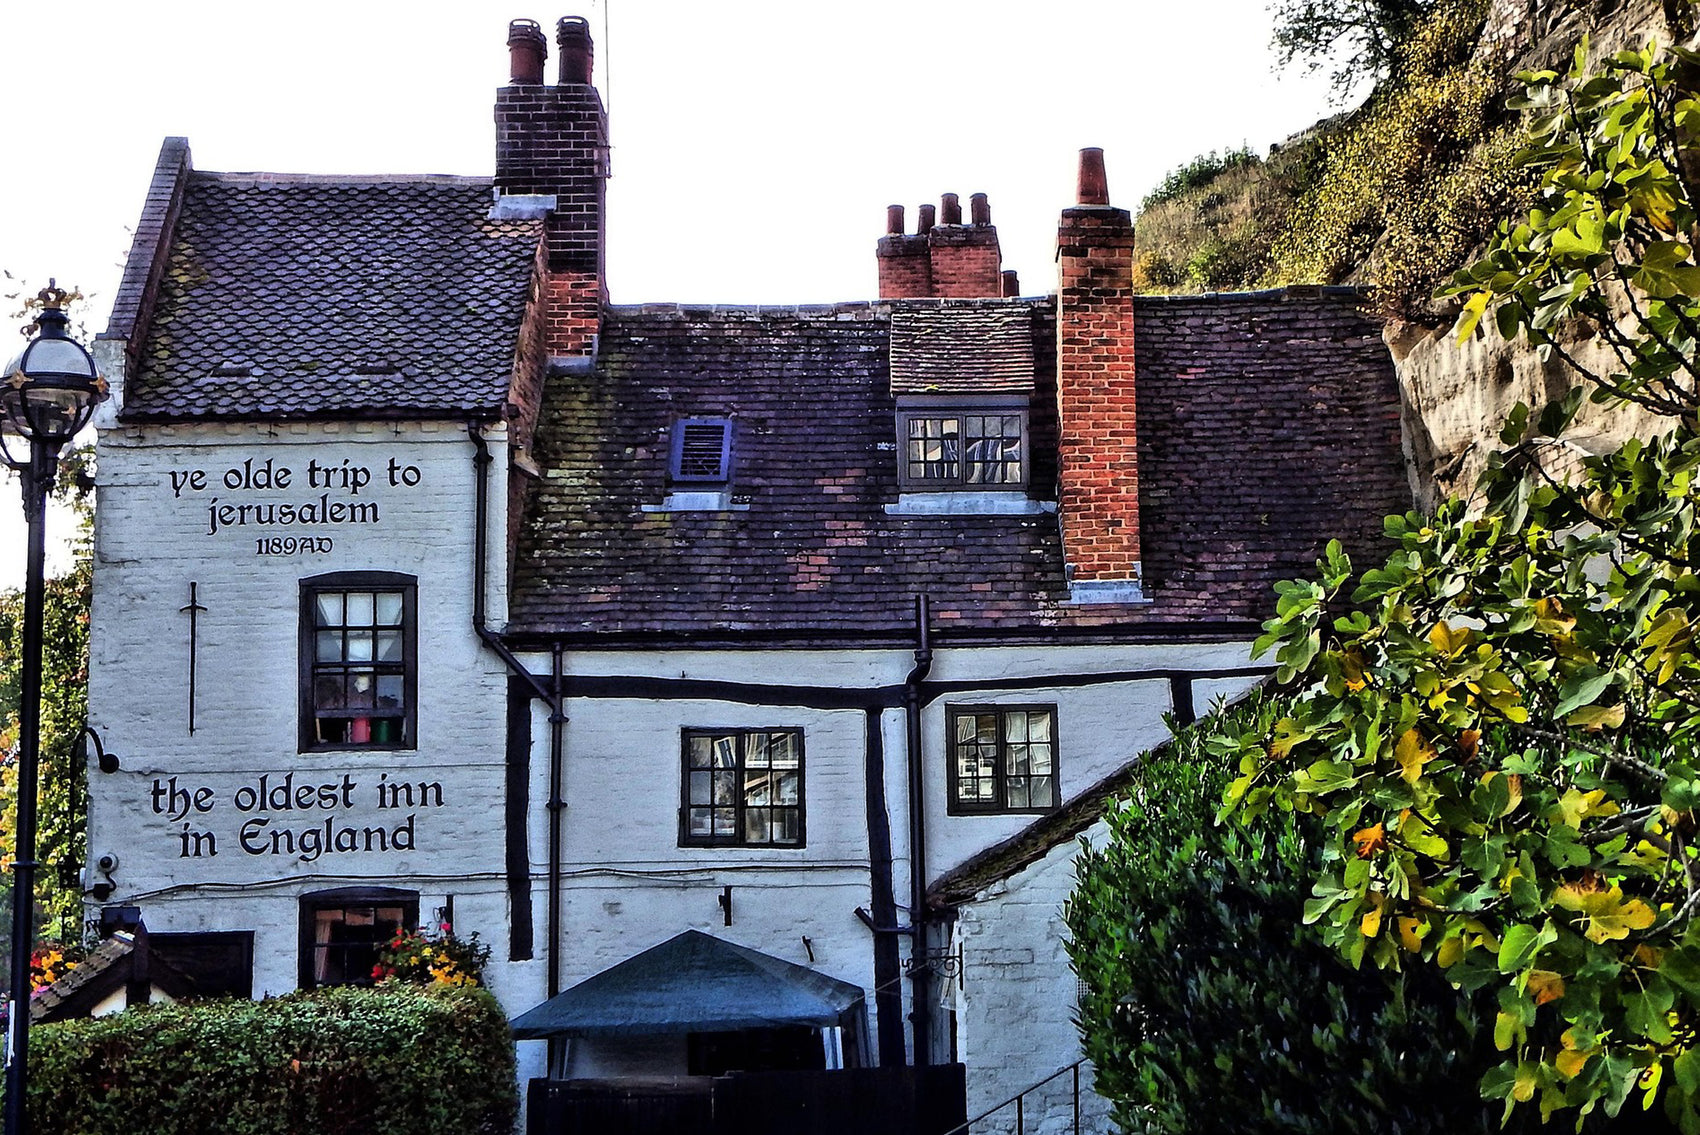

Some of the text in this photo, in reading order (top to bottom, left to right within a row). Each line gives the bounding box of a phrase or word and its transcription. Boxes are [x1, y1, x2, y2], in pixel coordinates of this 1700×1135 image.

[168, 457, 422, 498] ye olde trip to
[206, 493, 380, 535] jerusalem
[150, 771, 445, 822] the oldest inn
[179, 813, 416, 862] in England
